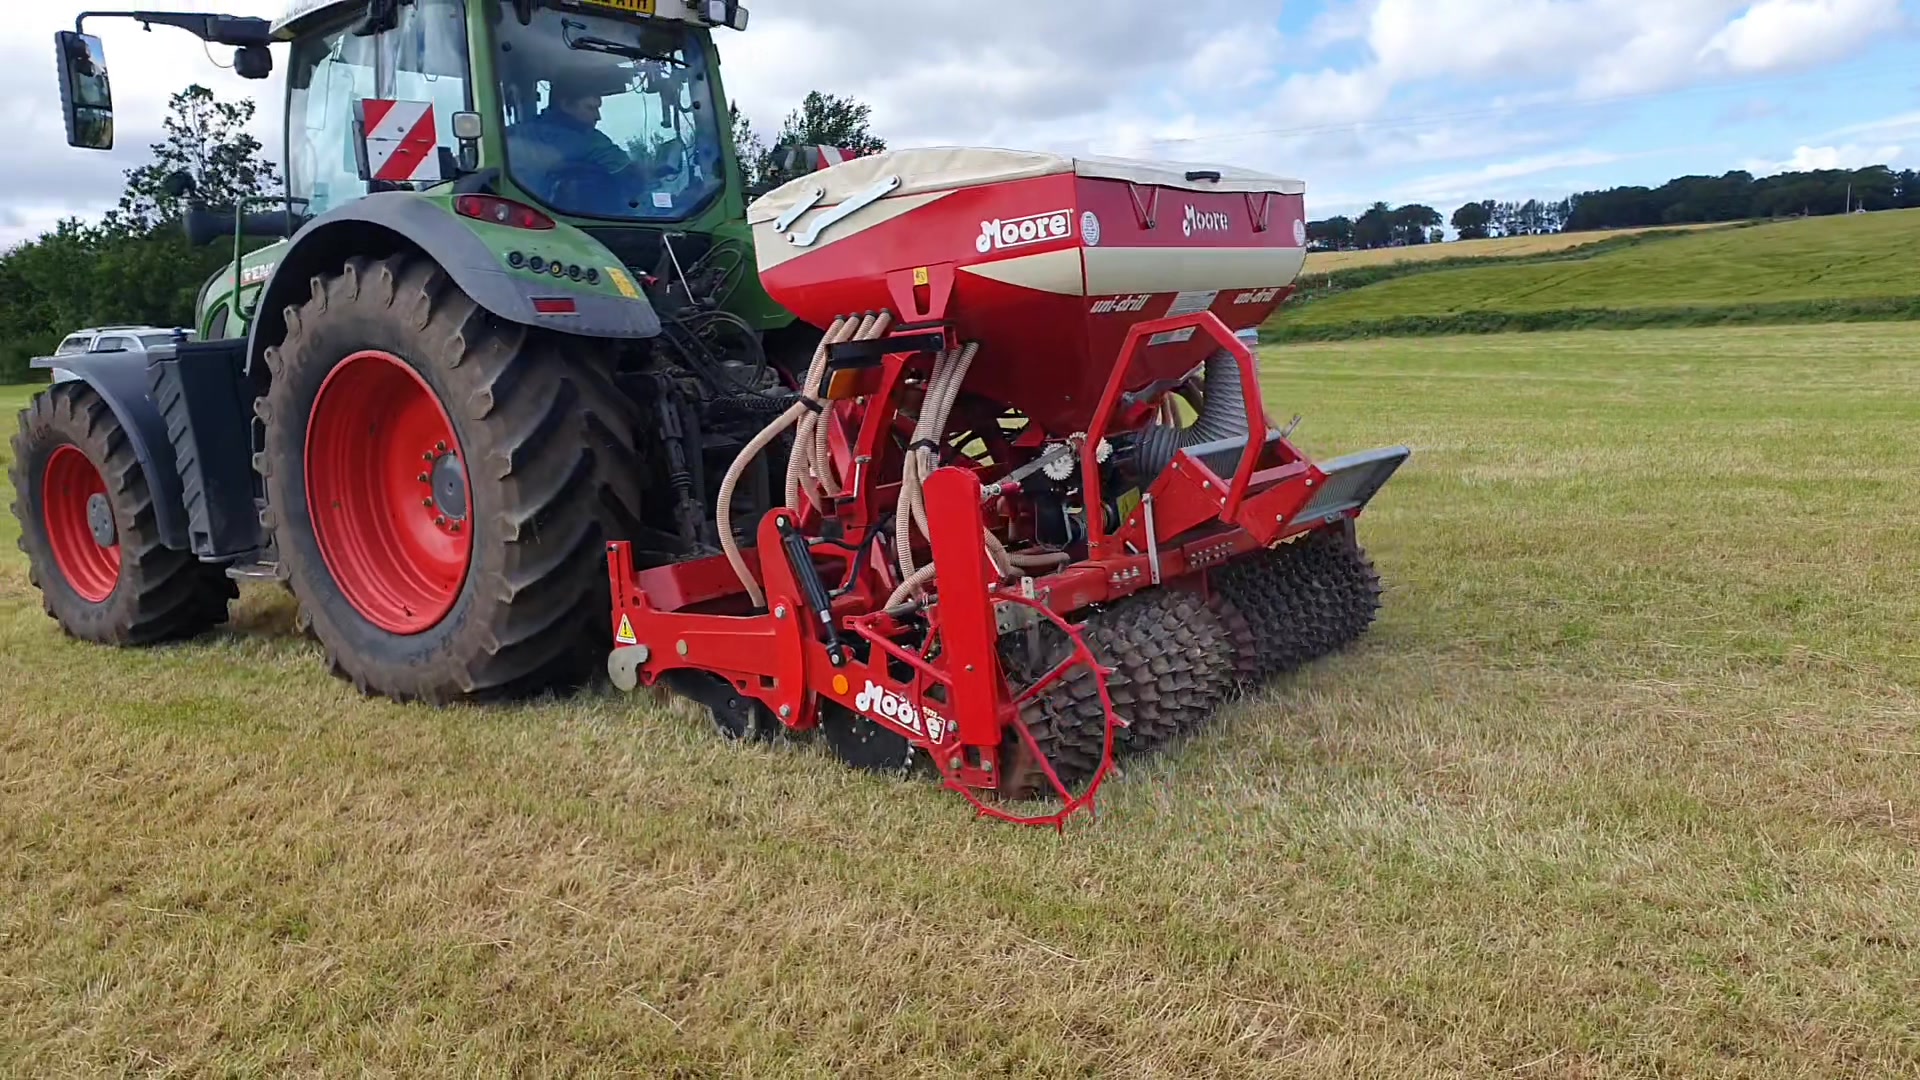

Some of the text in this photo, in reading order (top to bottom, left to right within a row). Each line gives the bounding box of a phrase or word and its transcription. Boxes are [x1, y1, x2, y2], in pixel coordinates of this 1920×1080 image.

[976, 214, 1067, 253] Moore
[1182, 204, 1228, 237] Moore
[1090, 294, 1151, 314] uni-drill
[1233, 288, 1280, 304] uni-drill
